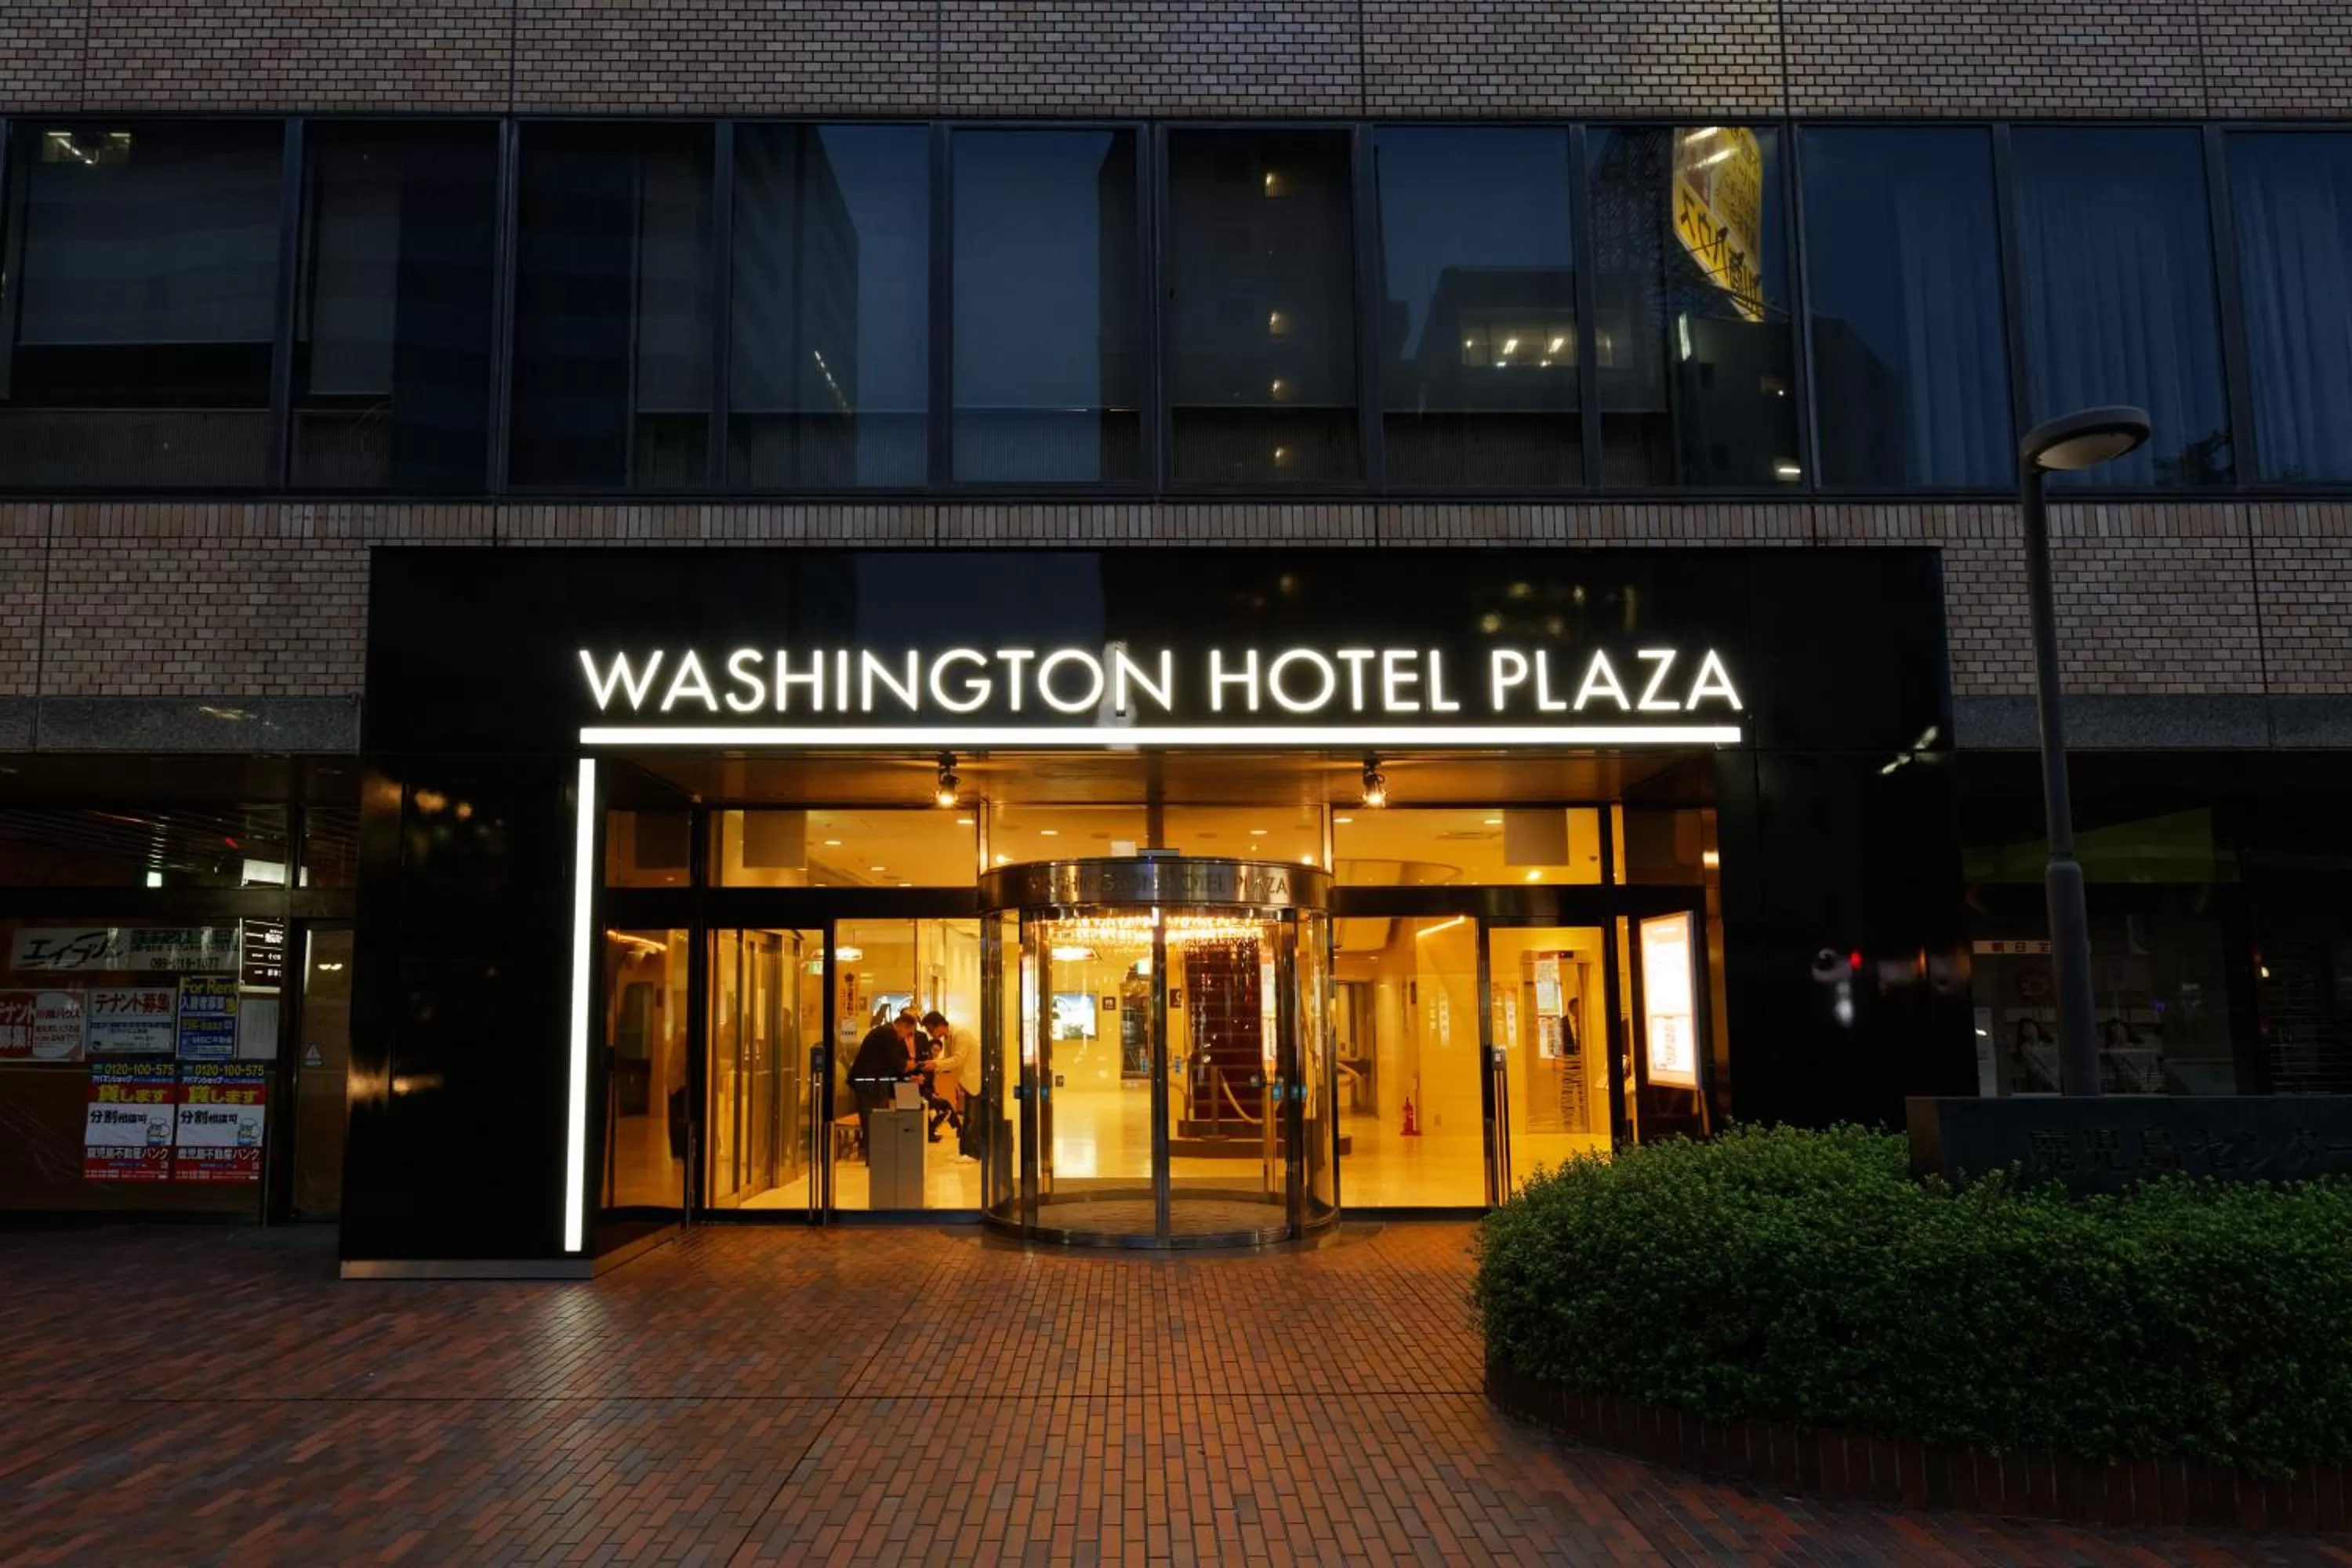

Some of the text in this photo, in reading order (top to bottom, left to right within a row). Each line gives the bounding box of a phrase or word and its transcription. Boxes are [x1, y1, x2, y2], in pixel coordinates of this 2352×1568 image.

[579, 648, 1743, 713] WASHINGTON HOTEL PLAZA
[1233, 874, 1288, 894] PLAZA
[104, 1063, 175, 1076] 0120-100-575
[194, 1064, 264, 1076] 0120-100-575
[98, 1083, 168, 1103] 貸します
[188, 1085, 260, 1104] 貸します
